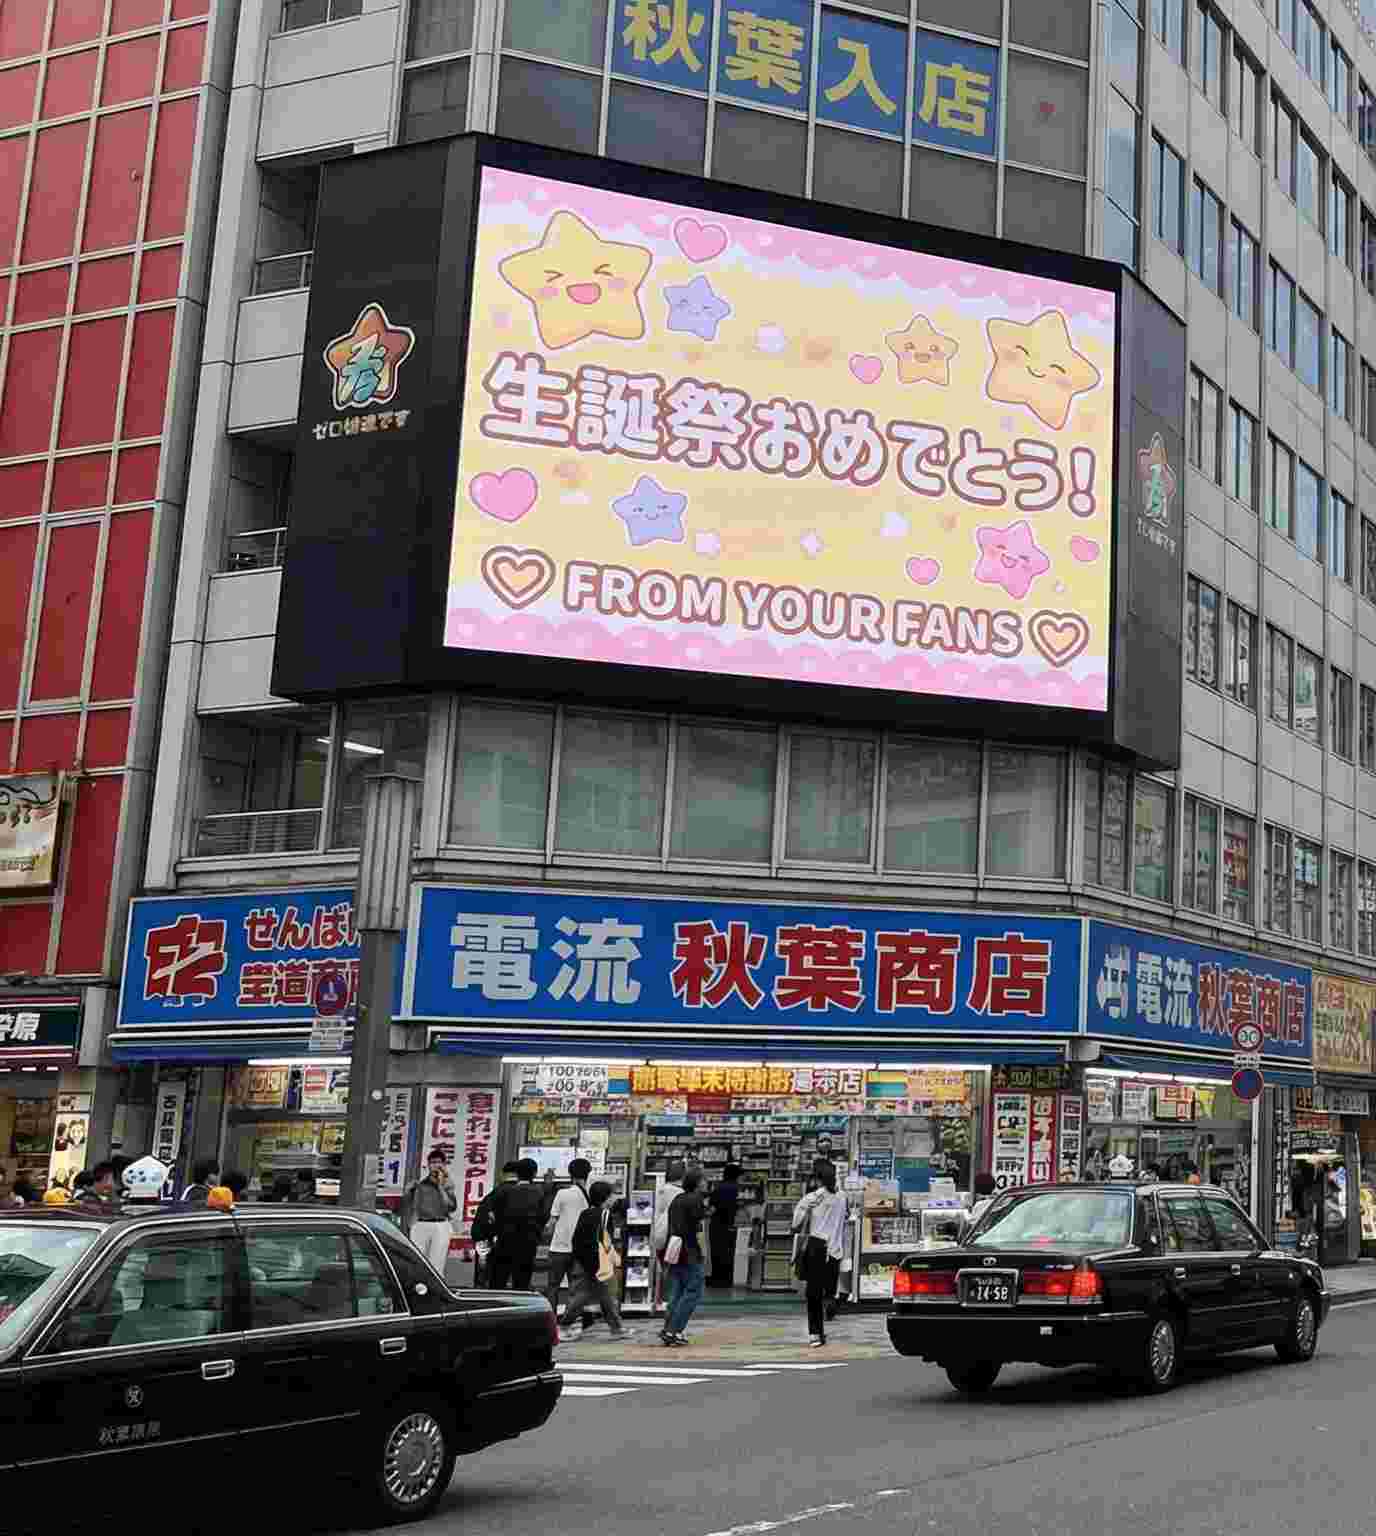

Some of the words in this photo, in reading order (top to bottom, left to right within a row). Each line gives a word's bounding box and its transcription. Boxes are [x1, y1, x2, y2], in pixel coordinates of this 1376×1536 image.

[622, 0, 994, 138] 秋葉入店
[479, 350, 1098, 518] 生誕祭おめでとう!
[563, 560, 728, 628] FROM
[732, 579, 884, 642] YOUR
[889, 598, 1027, 659] FANS
[243, 902, 361, 951] せんば
[448, 912, 645, 1005] 電流
[669, 918, 1055, 1018] 秋葉商店
